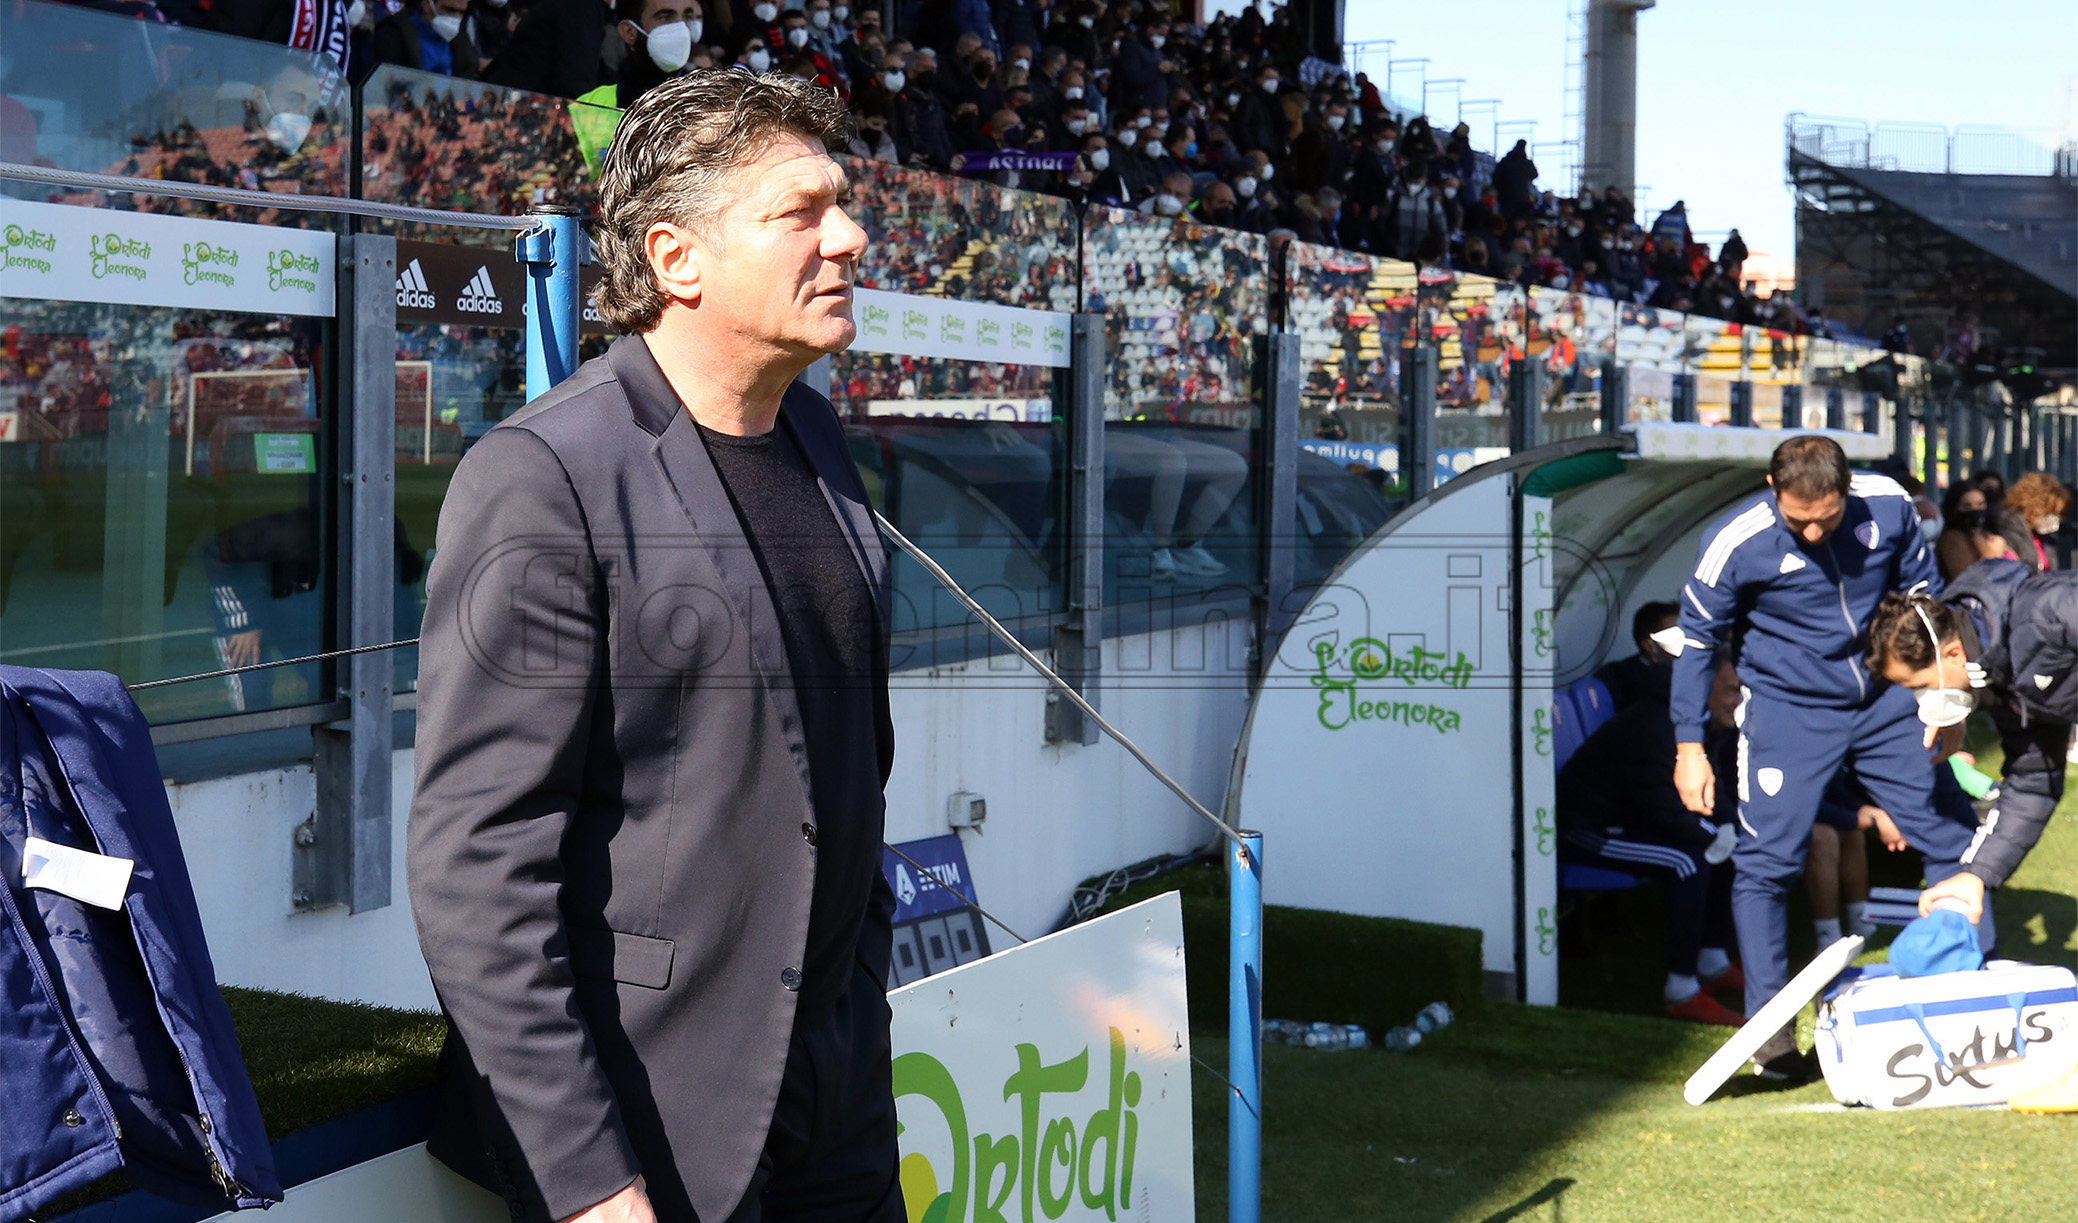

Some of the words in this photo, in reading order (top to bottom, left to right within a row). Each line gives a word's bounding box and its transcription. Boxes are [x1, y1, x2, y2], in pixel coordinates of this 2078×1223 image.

[0, 224, 56, 252] 'Ortodi
[91, 255, 147, 281] Eleonora
[183, 263, 235, 287] Eleonora
[268, 270, 316, 293] Eleonora
[396, 289, 436, 309] didas
[456, 294, 503, 314] adidas
[1310, 637, 1473, 689] L'Ortodi
[1317, 685, 1461, 734] Eleonora
[931, 862, 961, 888] TIM
[1886, 1011, 2053, 1107] Sixtus
